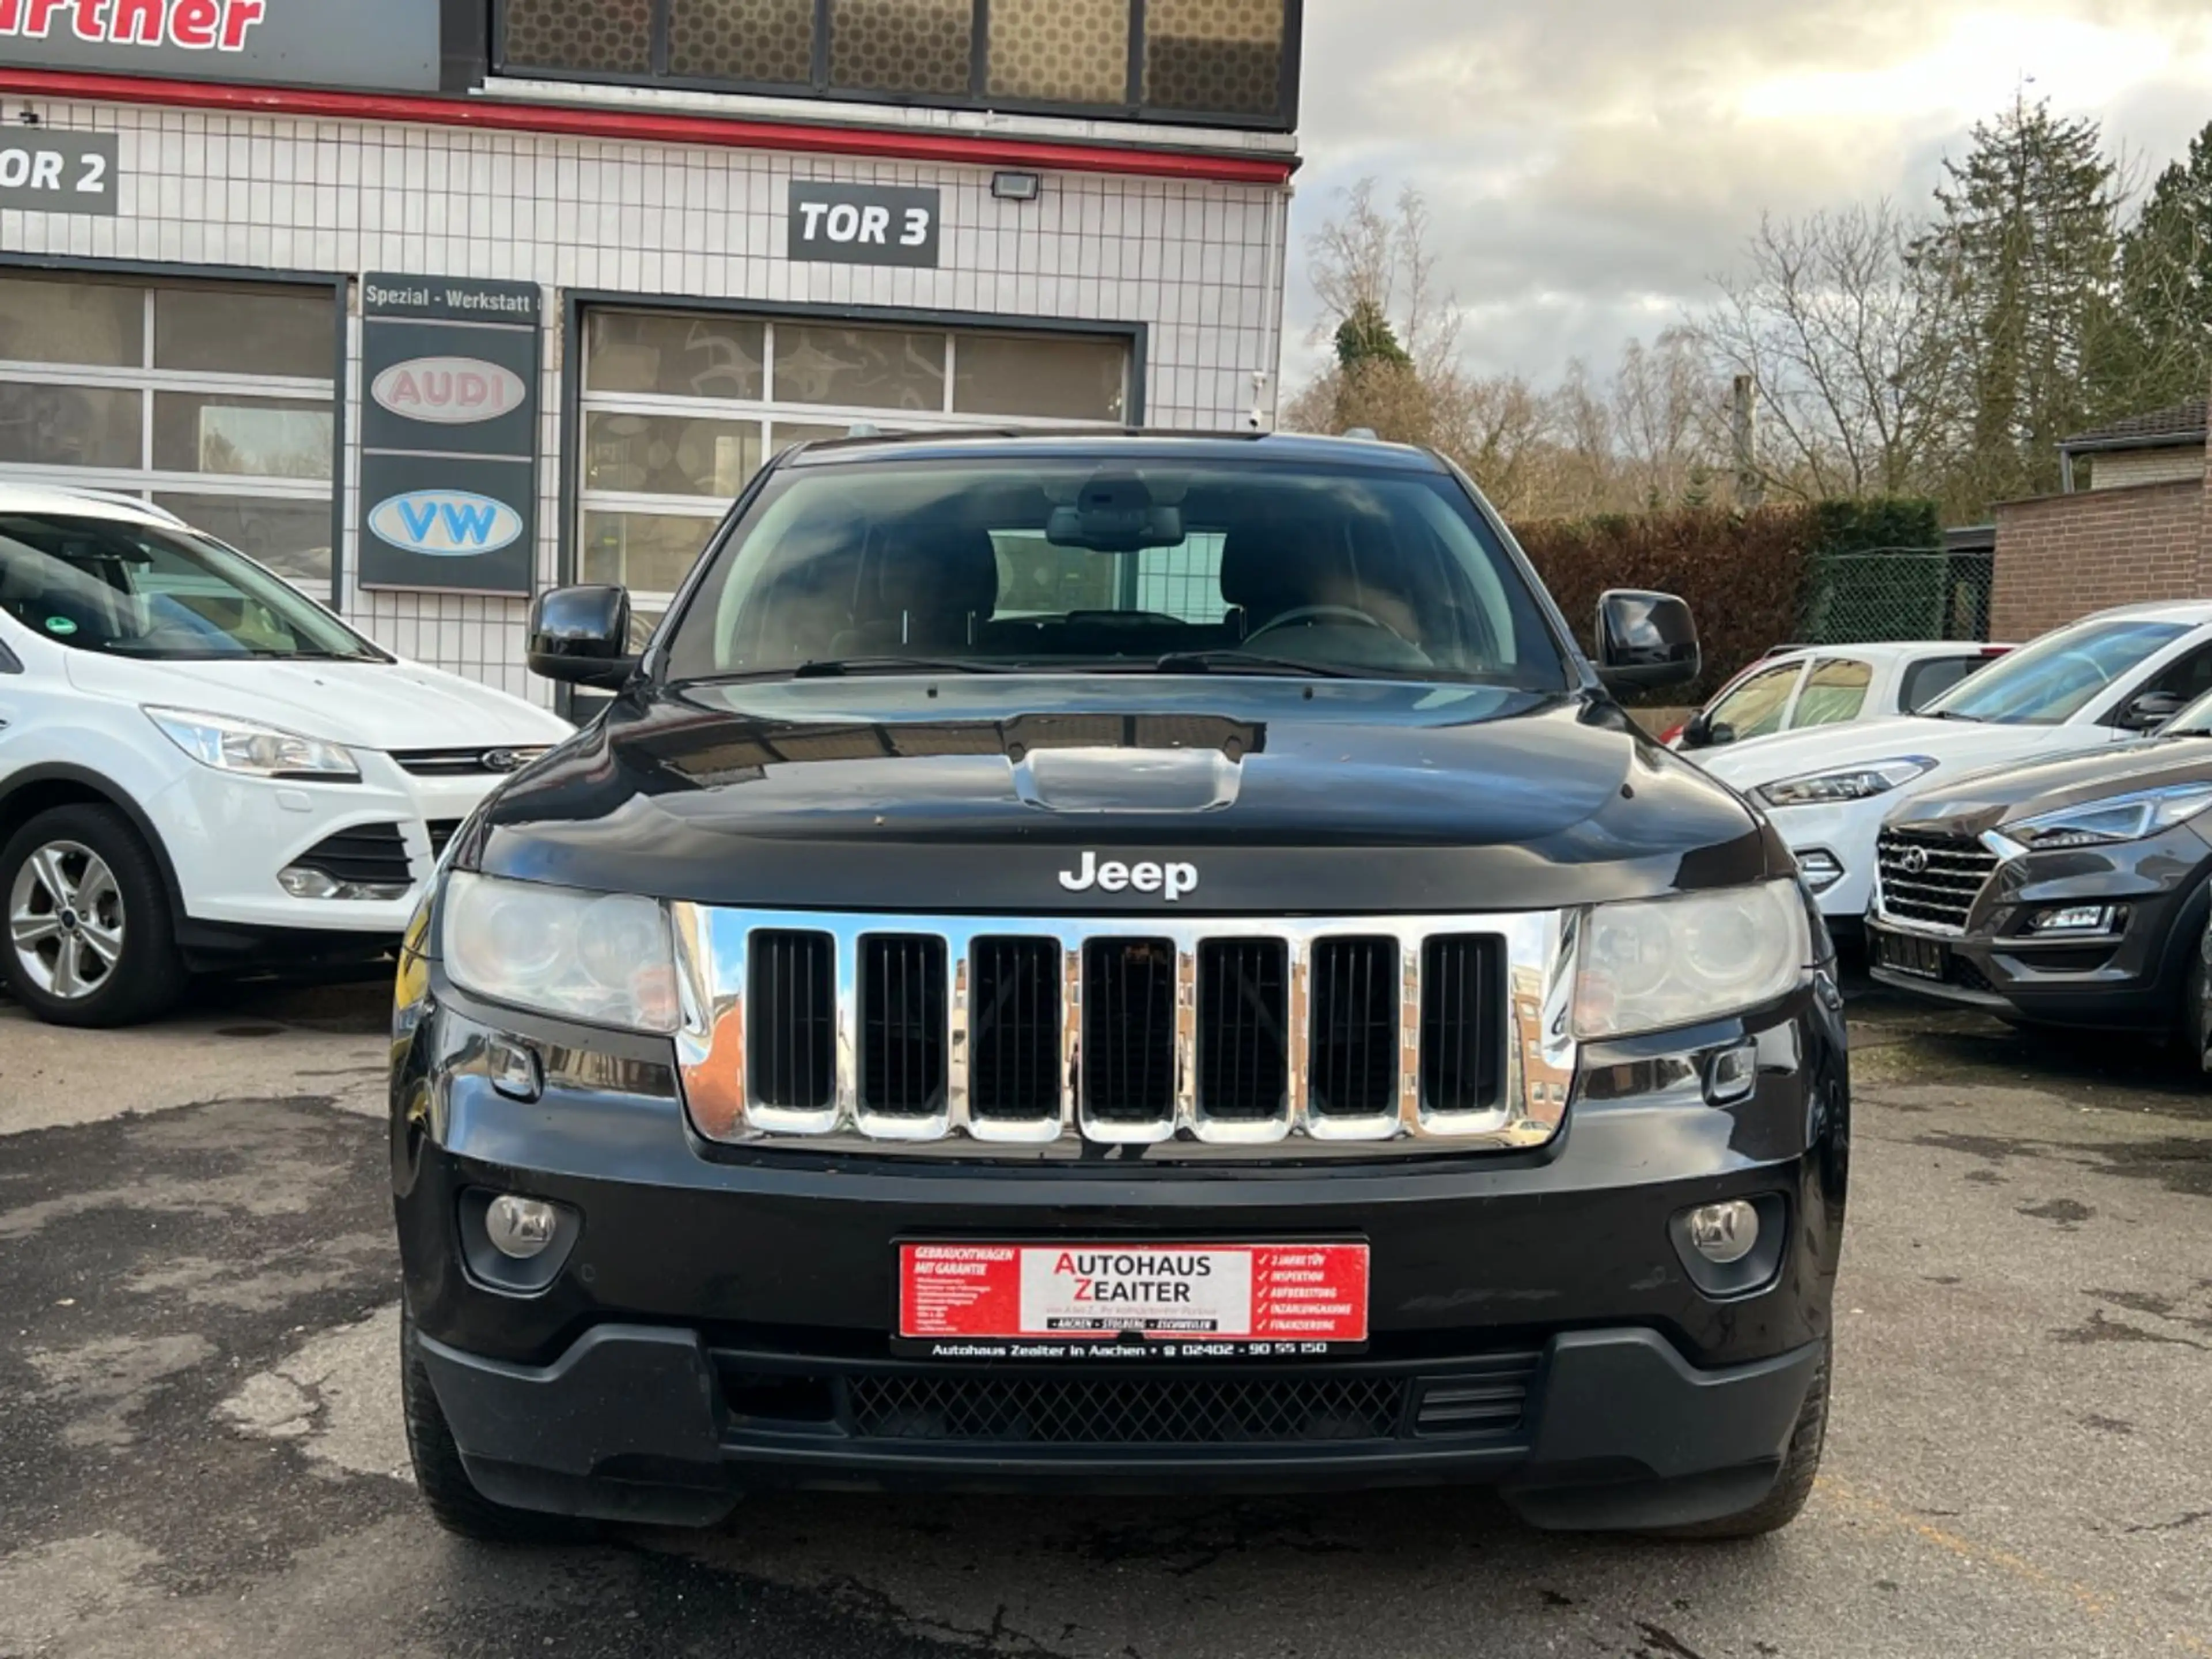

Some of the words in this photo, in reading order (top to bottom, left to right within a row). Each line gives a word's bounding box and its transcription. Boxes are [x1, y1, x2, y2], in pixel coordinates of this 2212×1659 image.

[76, 153, 106, 193] 2
[799, 202, 890, 244] TOR
[899, 208, 930, 246] 3
[366, 285, 429, 307] Spezial
[445, 289, 531, 312] Werkstatt
[388, 370, 505, 408] AUDI
[397, 498, 497, 545] VW
[1059, 851, 1198, 900] Jeep
[1054, 1252, 1210, 1276] AUTOHAUS
[1074, 1278, 1191, 1302] ZEAITER
[933, 1344, 1006, 1355] Autohaus
[1089, 1344, 1146, 1355] Aachen
[1183, 1343, 1234, 1355] 02402
[1248, 1342, 1271, 1354] 90
[1275, 1343, 1296, 1353] 55
[1300, 1342, 1327, 1353] 150
